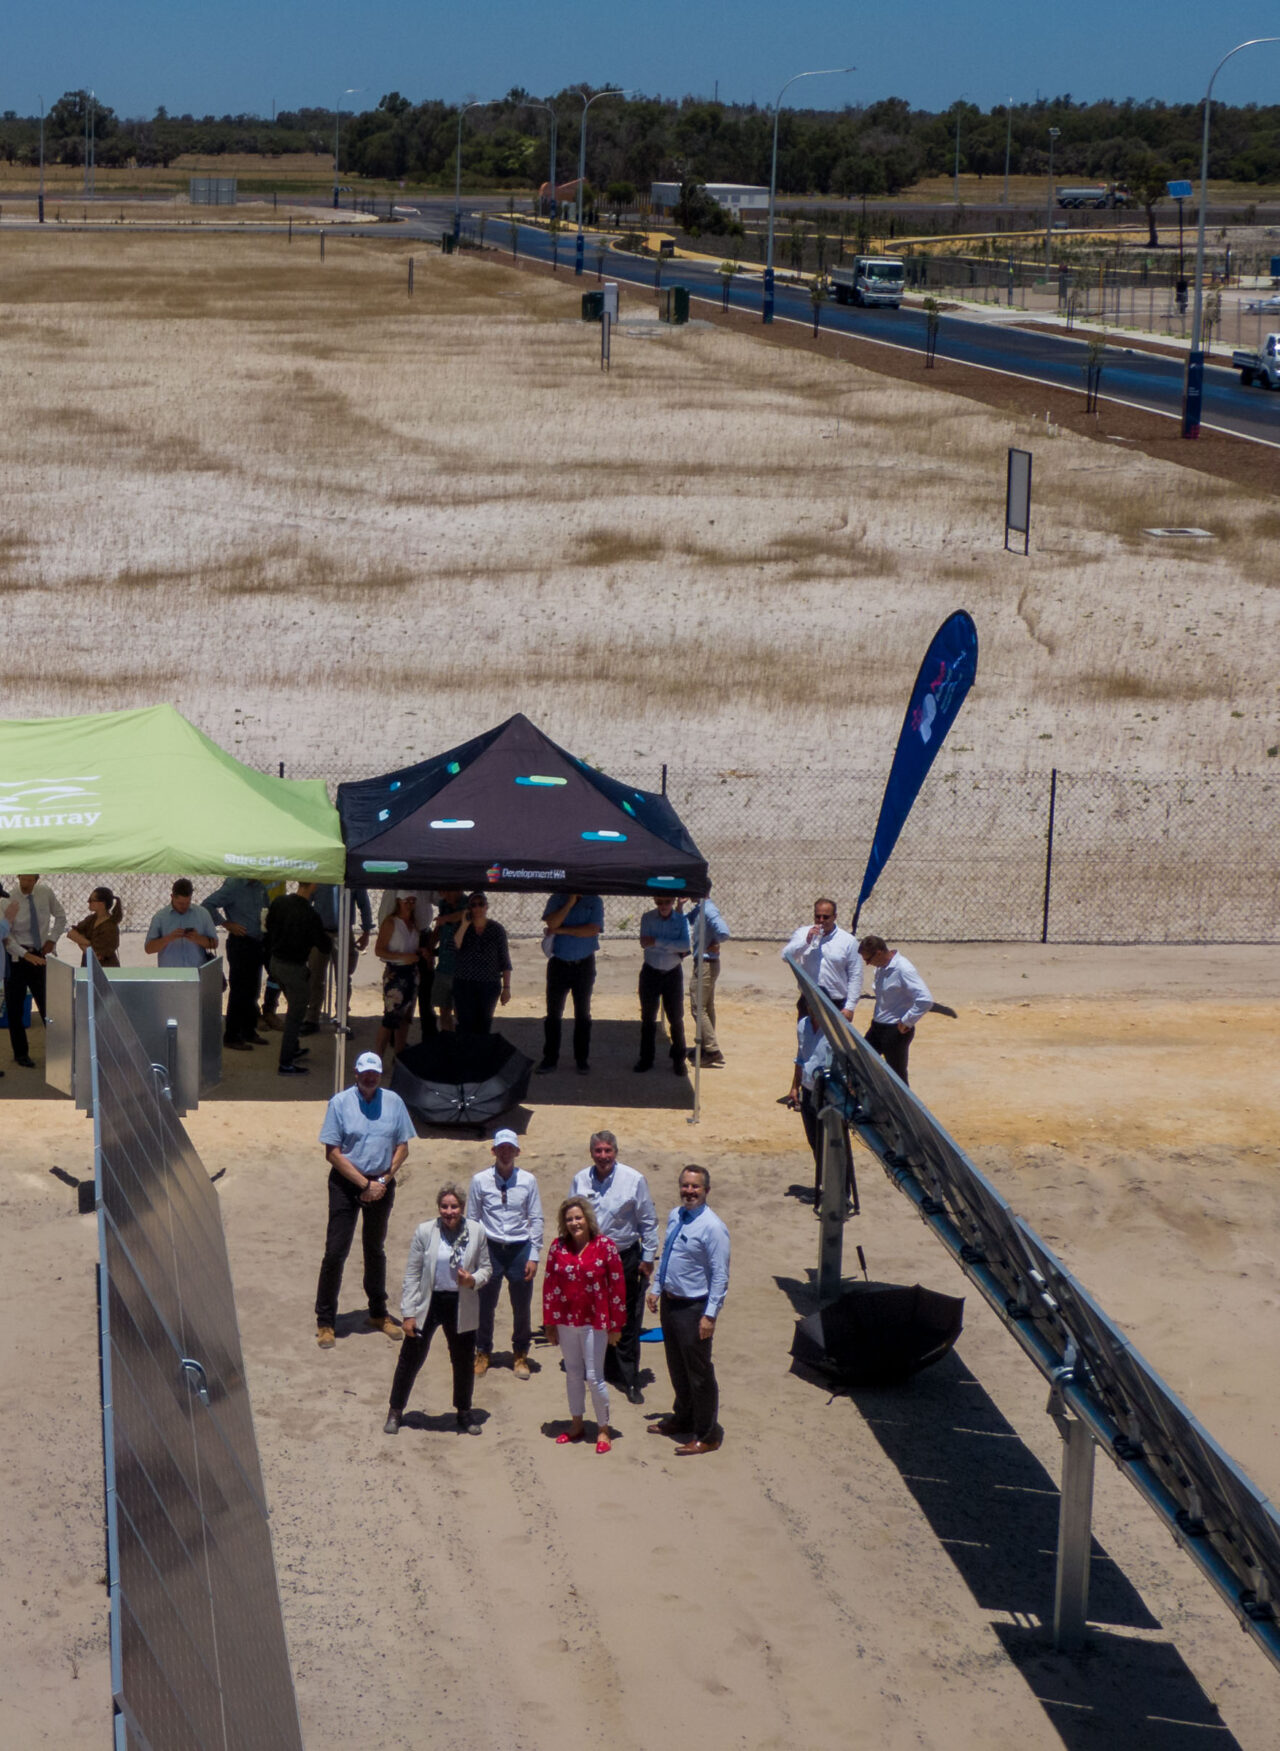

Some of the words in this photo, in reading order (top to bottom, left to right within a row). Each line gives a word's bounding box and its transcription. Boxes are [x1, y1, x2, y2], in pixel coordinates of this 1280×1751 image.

[224, 853, 257, 866] Shire
[258, 855, 271, 867] of
[273, 856, 319, 872] Murray
